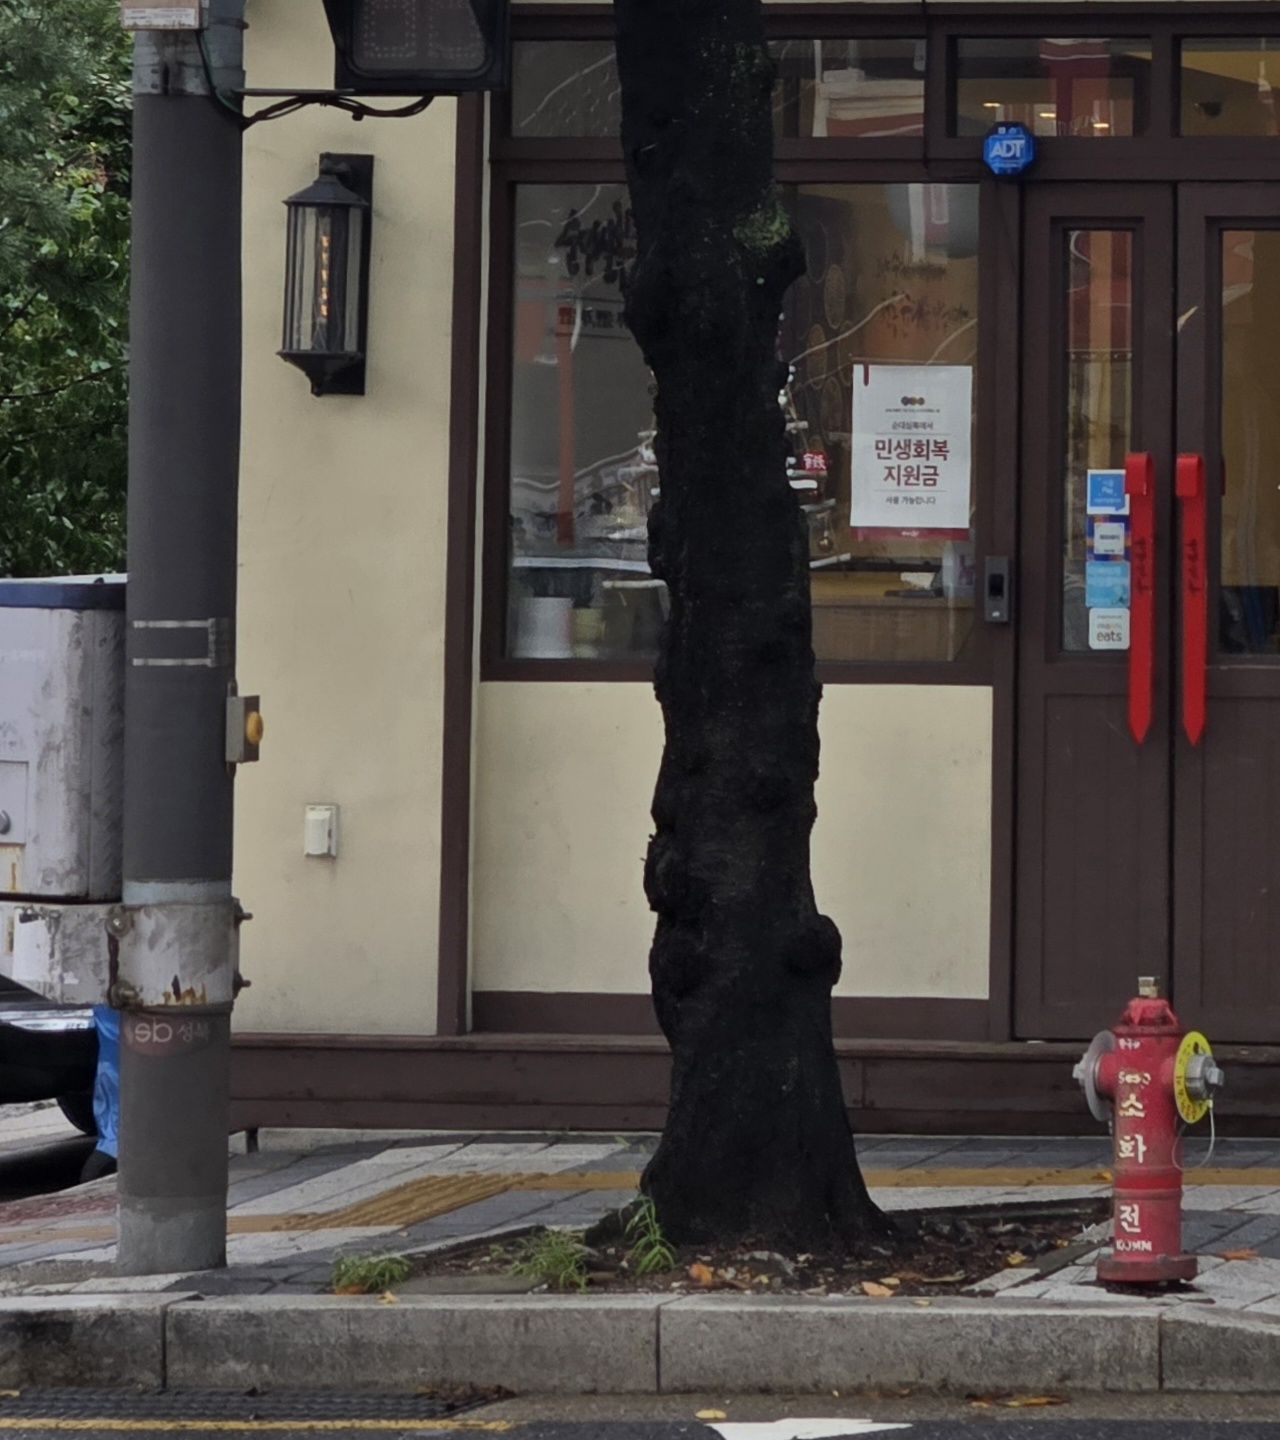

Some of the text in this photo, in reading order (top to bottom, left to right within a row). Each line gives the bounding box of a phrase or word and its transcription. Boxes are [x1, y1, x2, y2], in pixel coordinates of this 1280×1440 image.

[990, 139, 1025, 158] ADT
[874, 439, 950, 461] 민생회복
[883, 464, 940, 487] 지원금
[1096, 630, 1123, 642] eats
